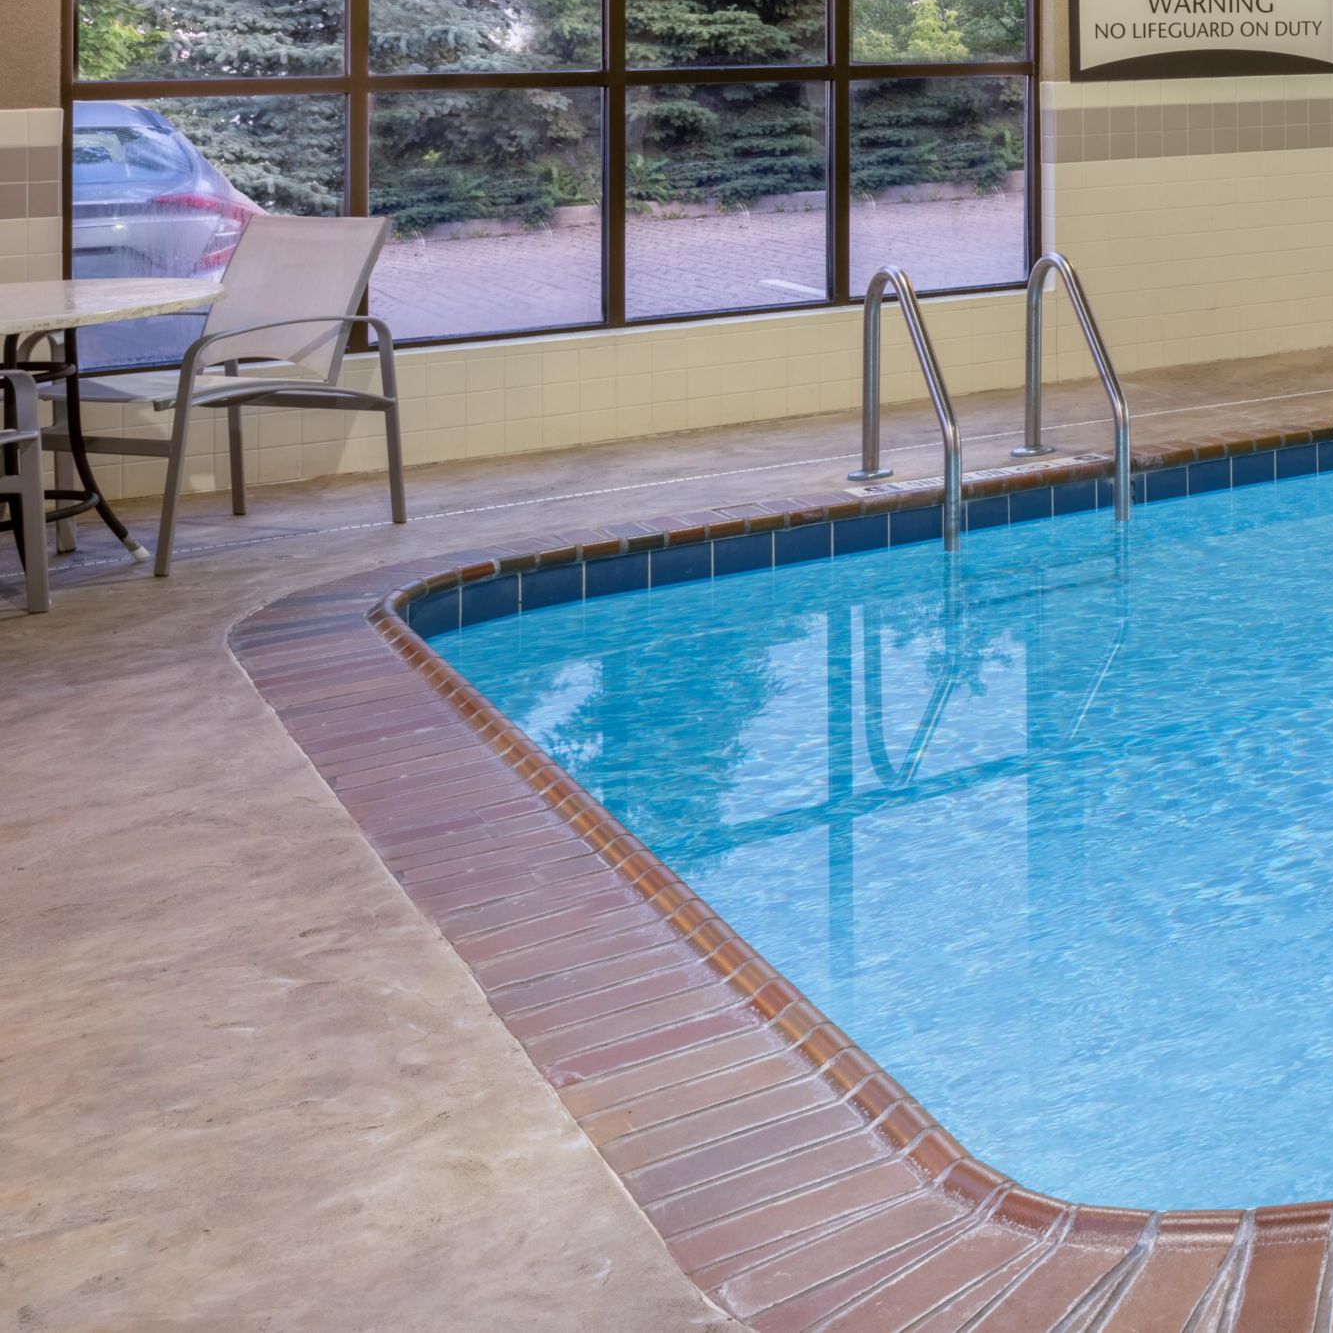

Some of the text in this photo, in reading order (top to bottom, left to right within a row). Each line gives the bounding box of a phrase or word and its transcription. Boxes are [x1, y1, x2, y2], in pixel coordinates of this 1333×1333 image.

[1094, 21, 1322, 39] NO LIFEGUARD ON DUTY
